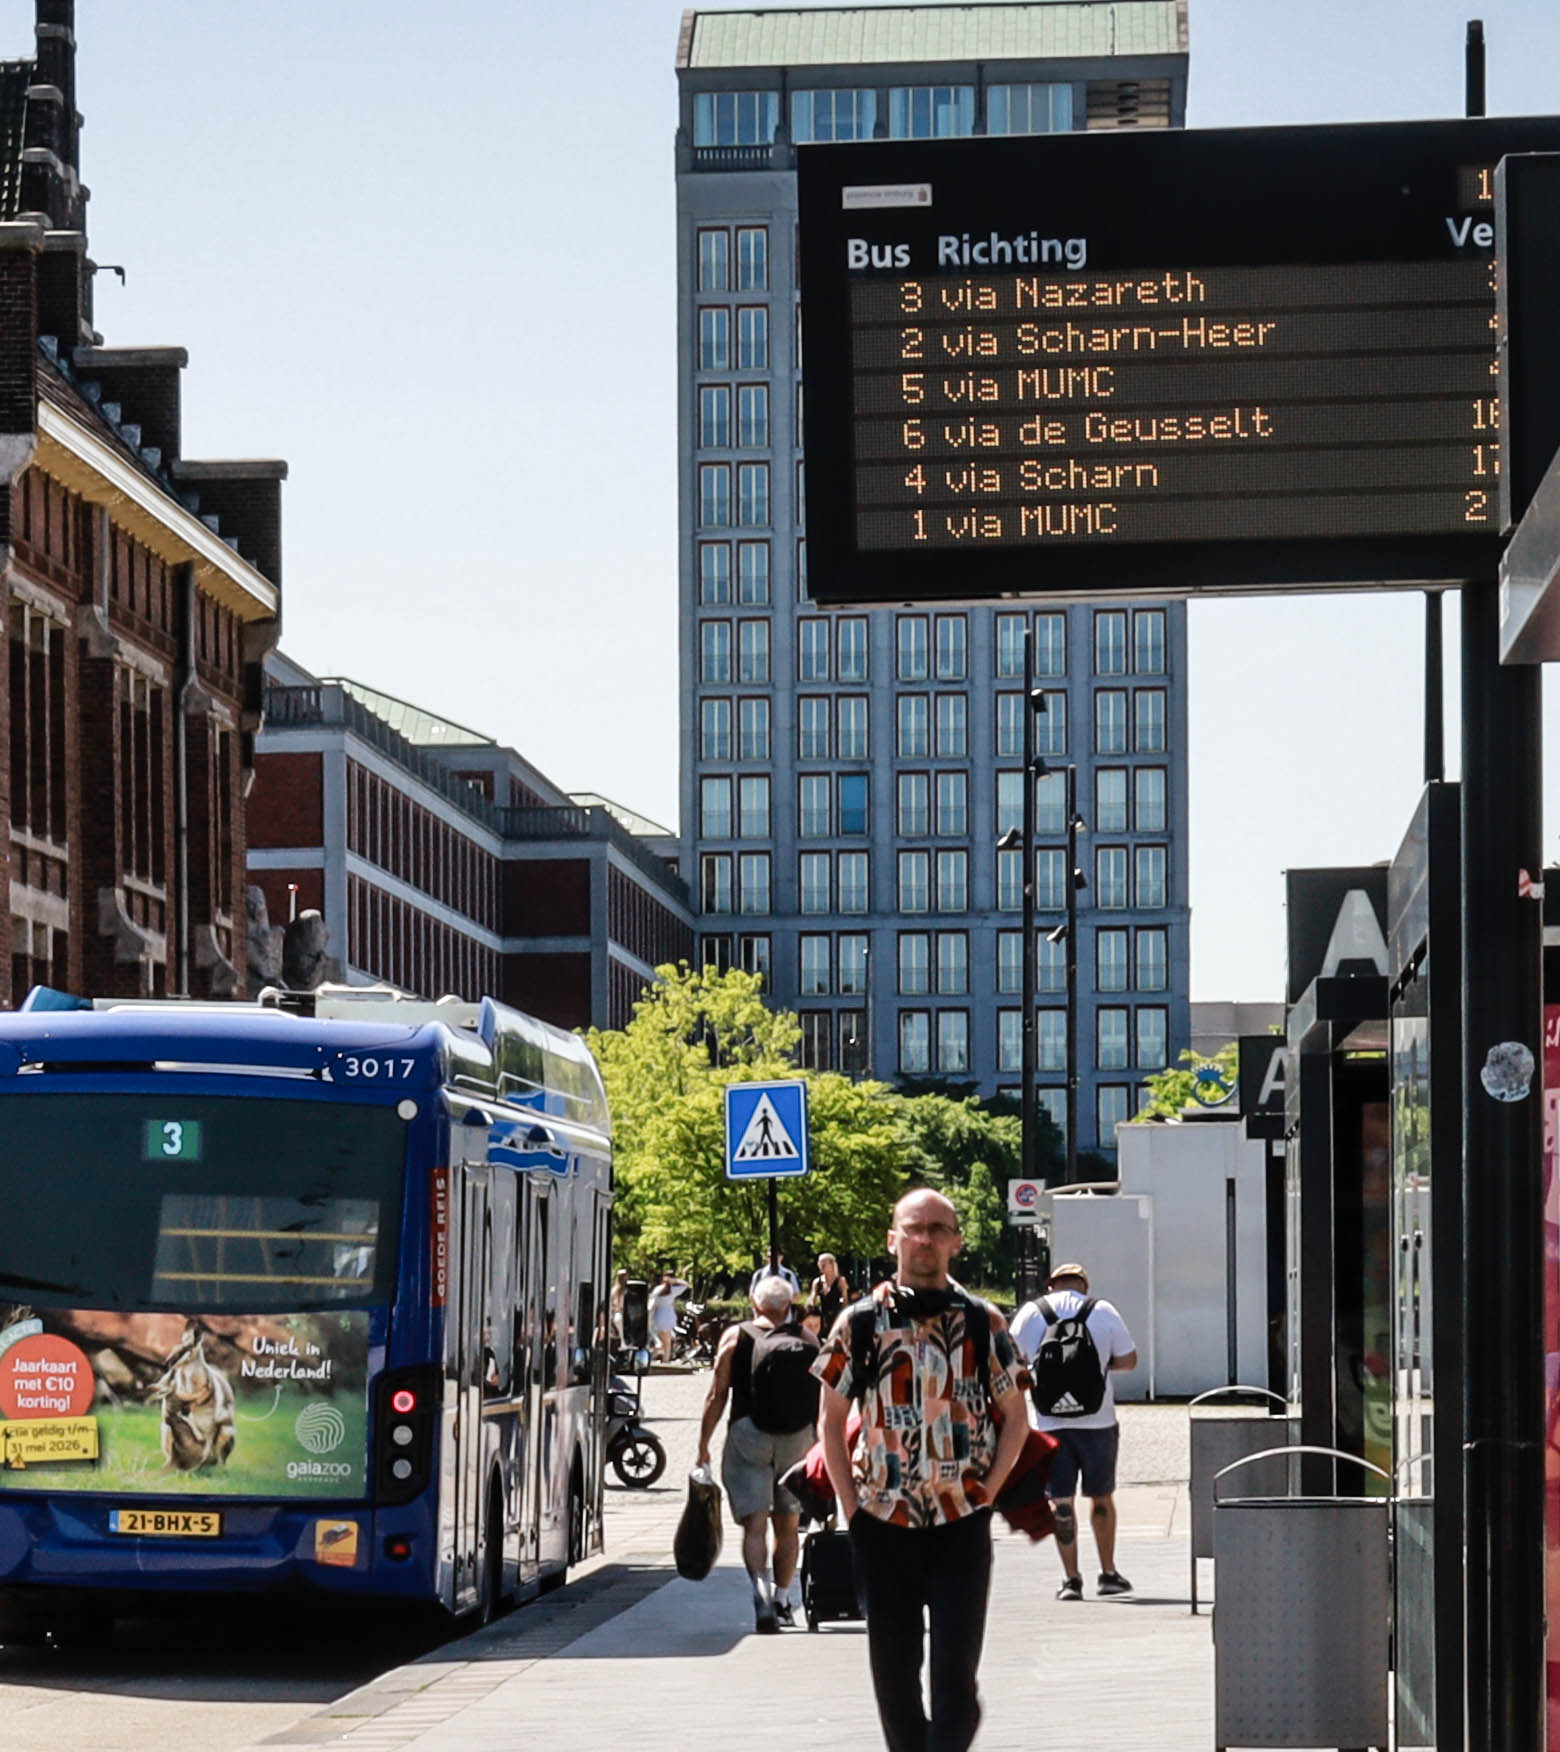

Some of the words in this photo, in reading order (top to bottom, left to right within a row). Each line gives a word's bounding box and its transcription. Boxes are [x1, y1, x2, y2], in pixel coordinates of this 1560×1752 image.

[847, 238, 911, 270] Bus
[937, 230, 1088, 270] Richting
[900, 281, 923, 313] 3
[941, 278, 998, 312] via
[1015, 269, 1208, 309] Nazareth
[901, 327, 924, 359] 2
[942, 325, 998, 357] via
[1016, 316, 1277, 355] Scharn-Heer
[902, 373, 925, 404] 5
[943, 371, 999, 403] via
[1018, 366, 1115, 400] MUMC
[903, 418, 926, 450] 6
[944, 416, 1000, 448] via
[1019, 414, 1067, 446] de
[1085, 406, 1274, 444] Geusselt
[904, 464, 927, 495] 4
[945, 462, 1001, 493] via
[1020, 458, 1159, 491] Scharn
[913, 509, 928, 541] 1
[946, 507, 1002, 539] via
[1021, 502, 1118, 537] MUMC
[344, 1056, 416, 1079] 3017
[161, 1122, 182, 1156] 3
[253, 1335, 301, 1356] Uniek
[306, 1341, 321, 1356] in
[12, 1357, 78, 1374] Jaarkaart
[241, 1359, 332, 1380] Nederland!
[14, 1378, 42, 1391] met
[45, 1376, 75, 1392] €10
[17, 1394, 71, 1412] korting!
[286, 1458, 352, 1479] gaiazoo
[126, 1513, 214, 1533] 21-BHX-5
